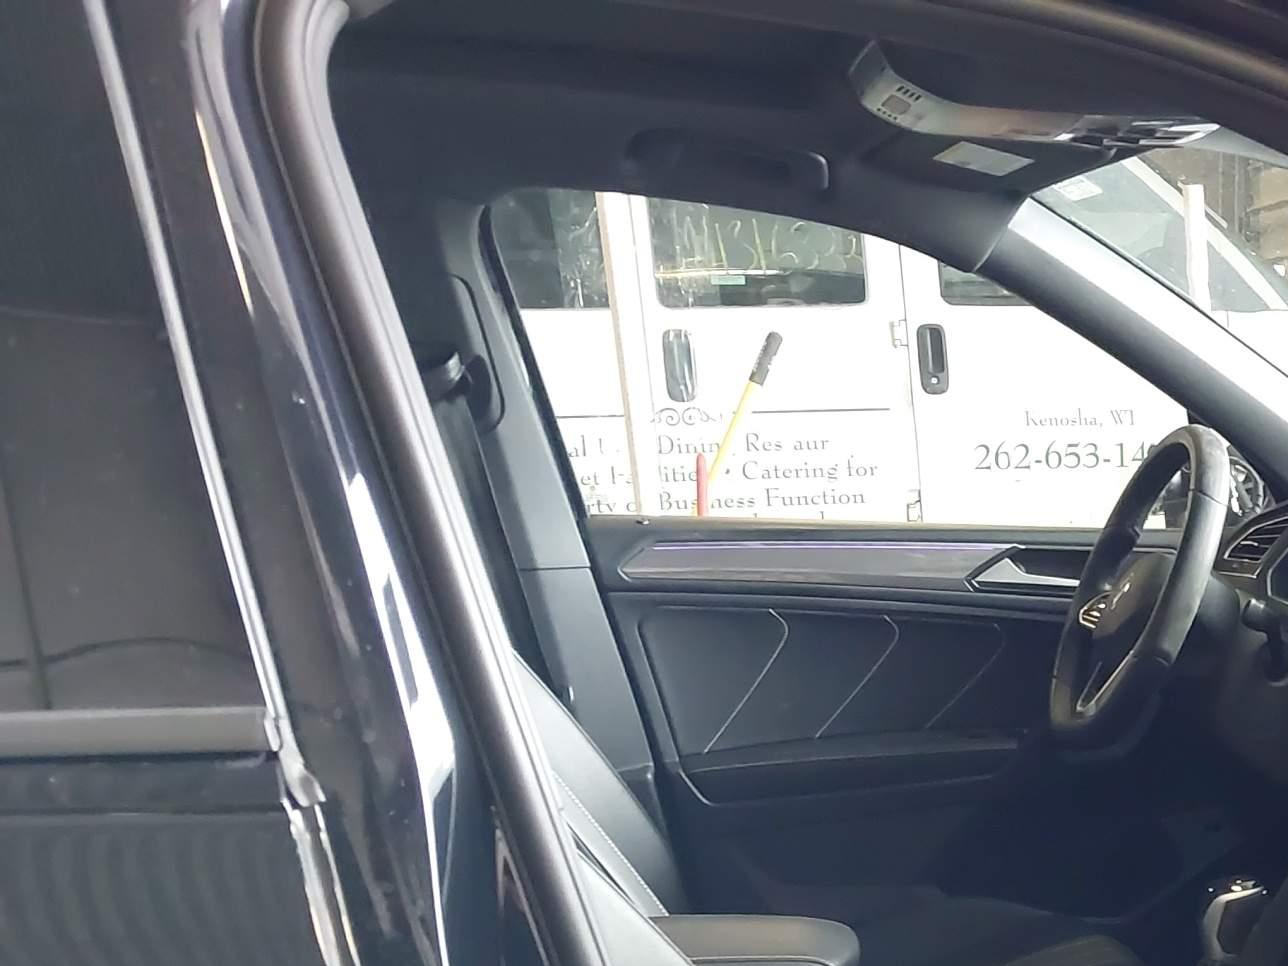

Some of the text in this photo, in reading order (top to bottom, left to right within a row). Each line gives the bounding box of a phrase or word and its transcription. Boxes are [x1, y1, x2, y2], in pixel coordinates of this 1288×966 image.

[1024, 407, 1137, 428] Kenosha, WI
[658, 434, 721, 455] Dinin
[741, 460, 839, 482] Catering
[847, 454, 879, 478] for
[764, 486, 867, 507] Function
